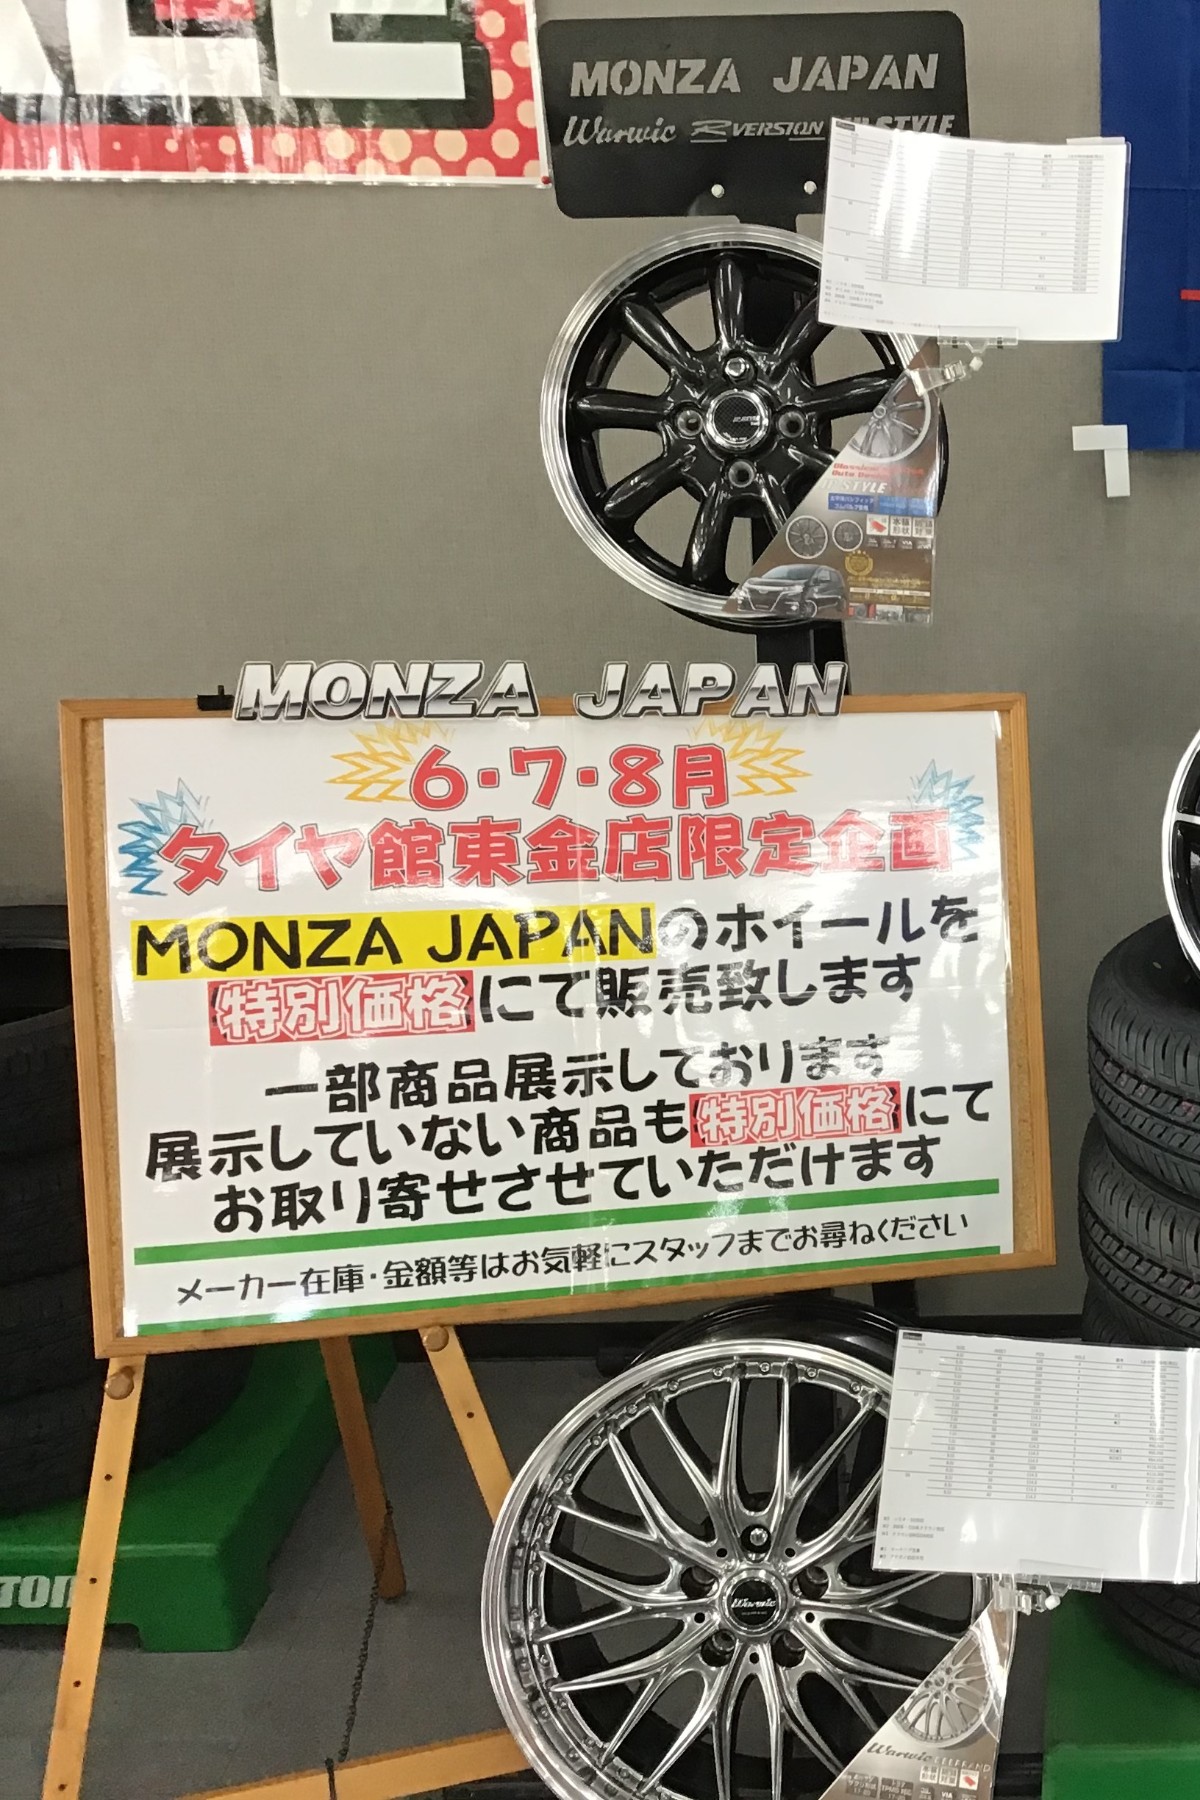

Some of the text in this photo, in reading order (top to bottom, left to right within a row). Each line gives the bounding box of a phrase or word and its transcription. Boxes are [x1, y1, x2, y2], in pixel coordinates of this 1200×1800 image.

[569, 53, 939, 97] MONZA JAPAN
[563, 115, 677, 147] Warwic
[232, 660, 849, 722] MONZA JAPAN
[157, 811, 956, 896] タイヤ館東金店限定企画
[136, 916, 403, 976] MONZA
[265, 1033, 891, 1114] 一部商品展示しております
[213, 1134, 941, 1234] お取り寄せさせていただけます
[866, 1741, 933, 1762] Warwic
